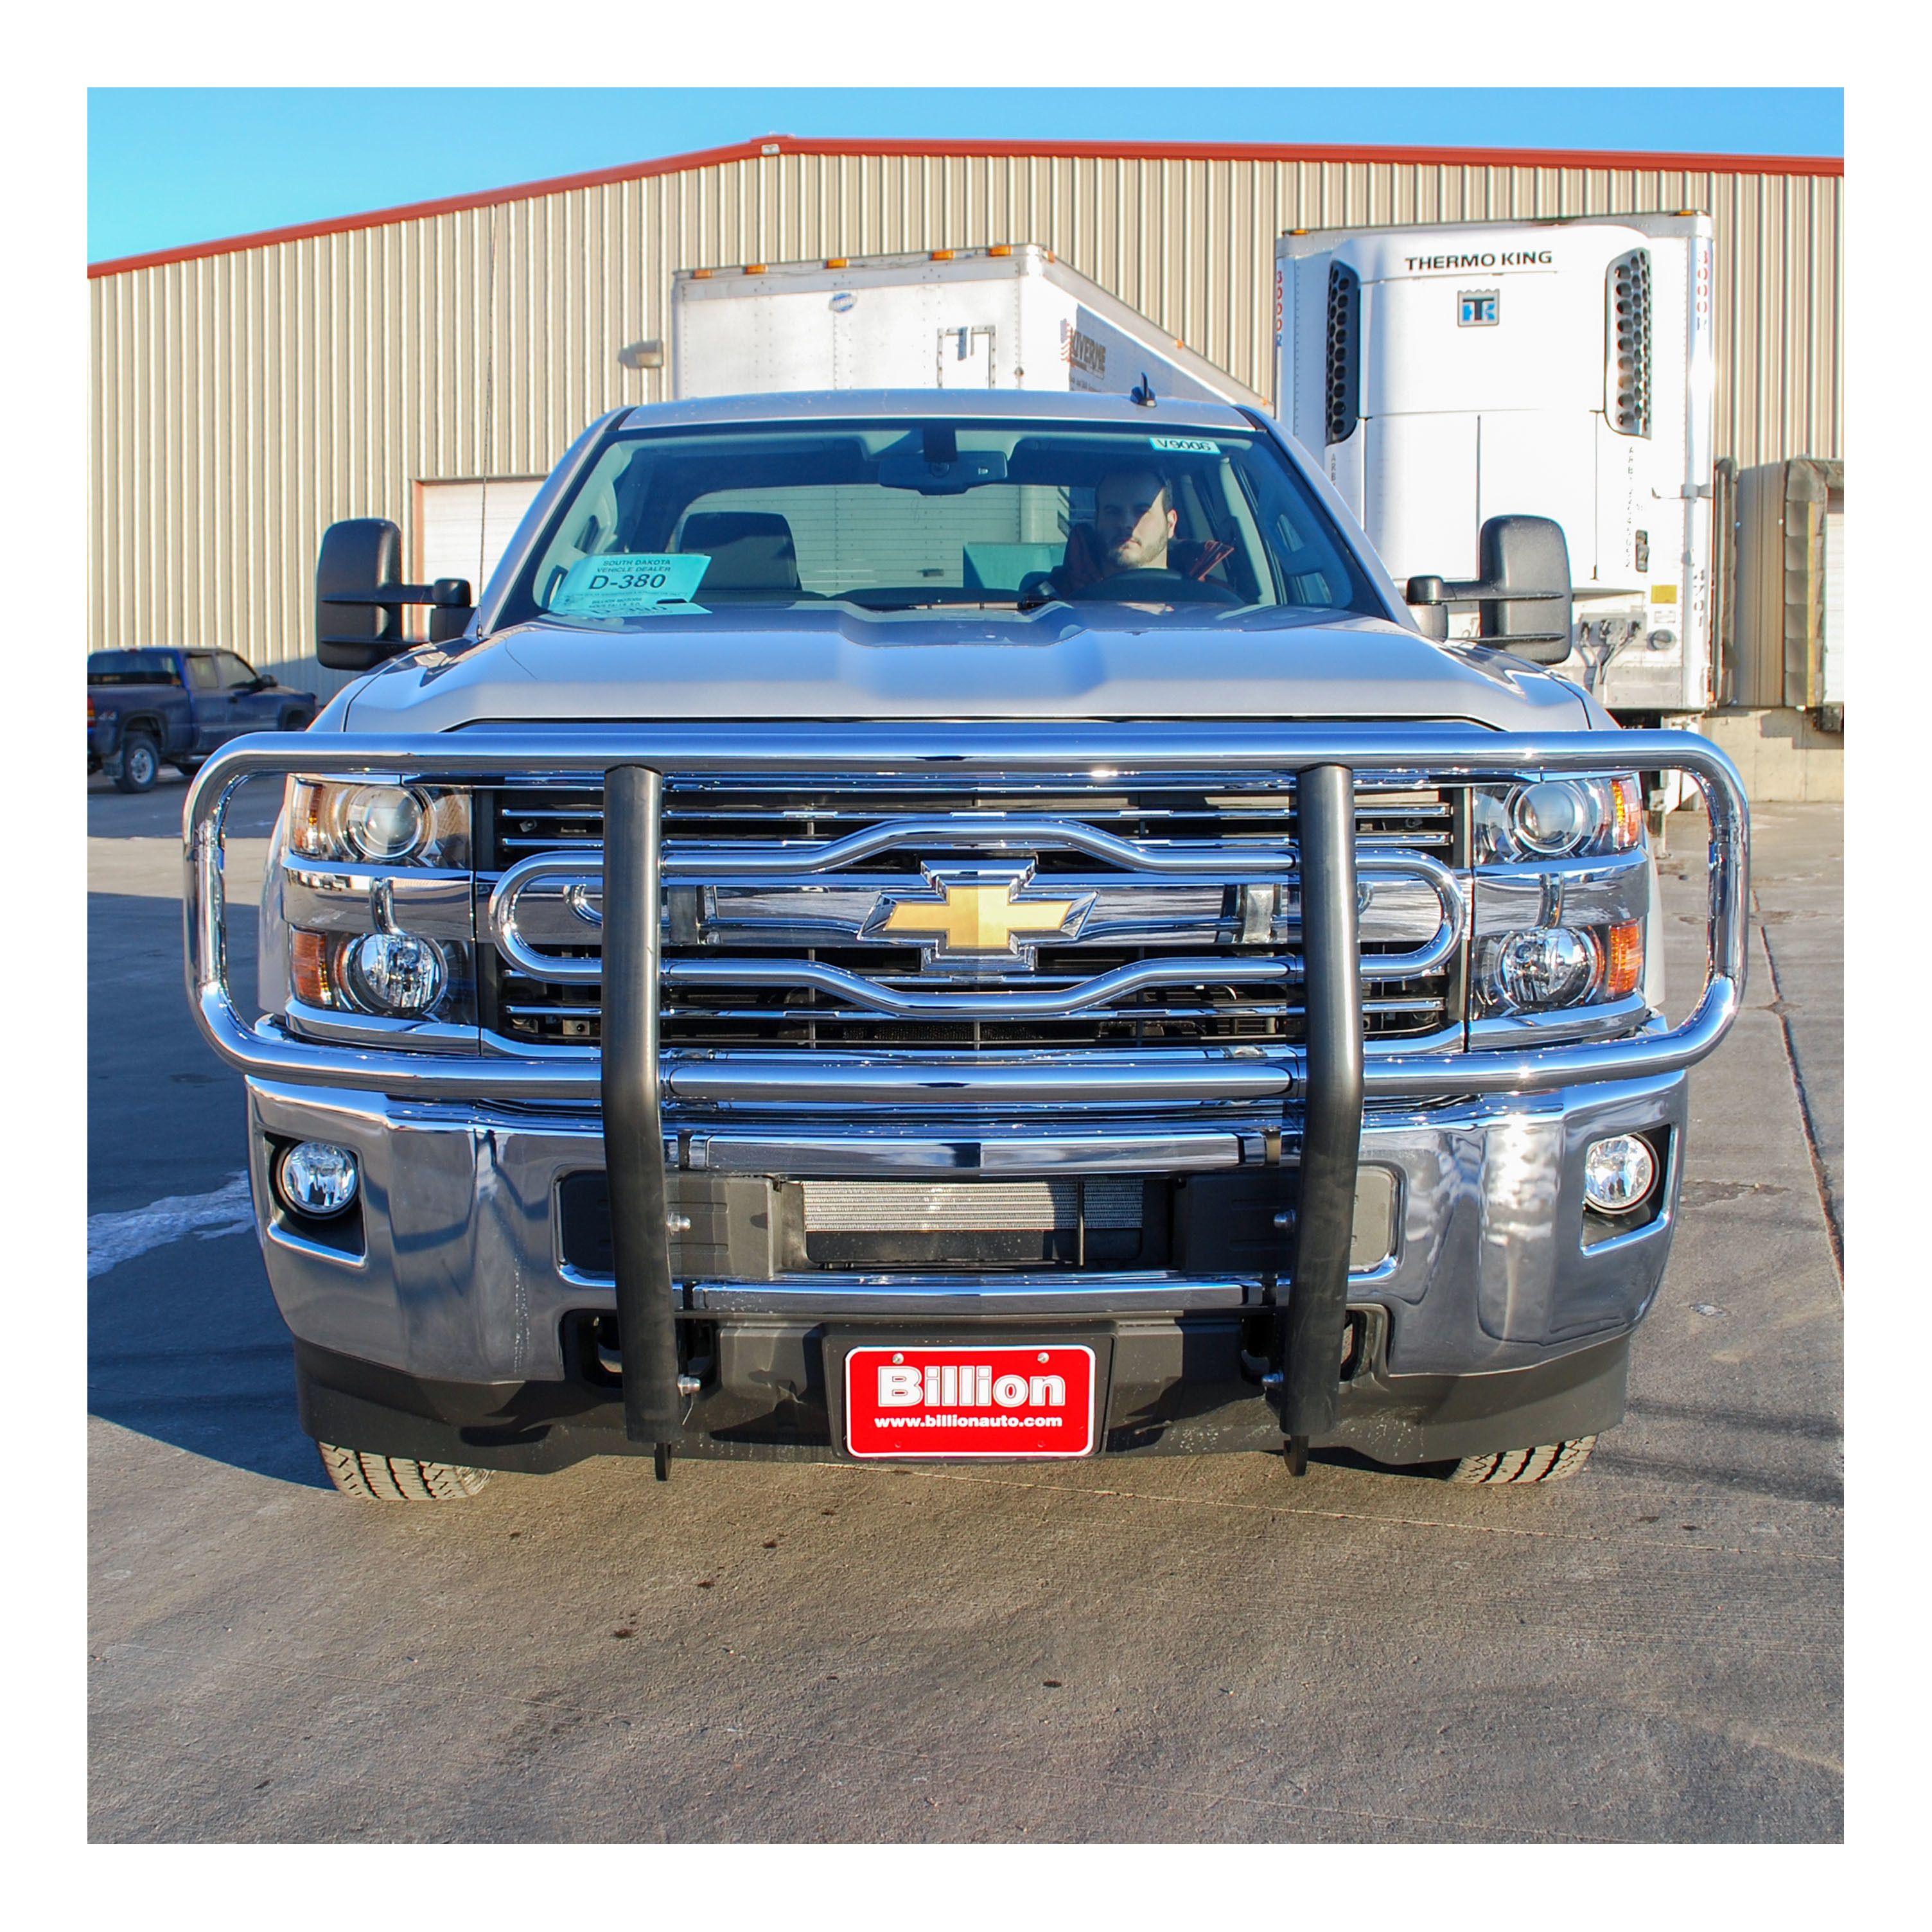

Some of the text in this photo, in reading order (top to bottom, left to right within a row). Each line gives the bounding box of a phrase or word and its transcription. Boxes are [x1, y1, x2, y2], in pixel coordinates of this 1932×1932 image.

[1405, 250, 1552, 271] THERMO KING
[1157, 439, 1211, 451] V9006
[588, 574, 667, 590] D-380
[877, 1365, 1067, 1408] Billion
[874, 1414, 1064, 1428] www.billionauto.com
